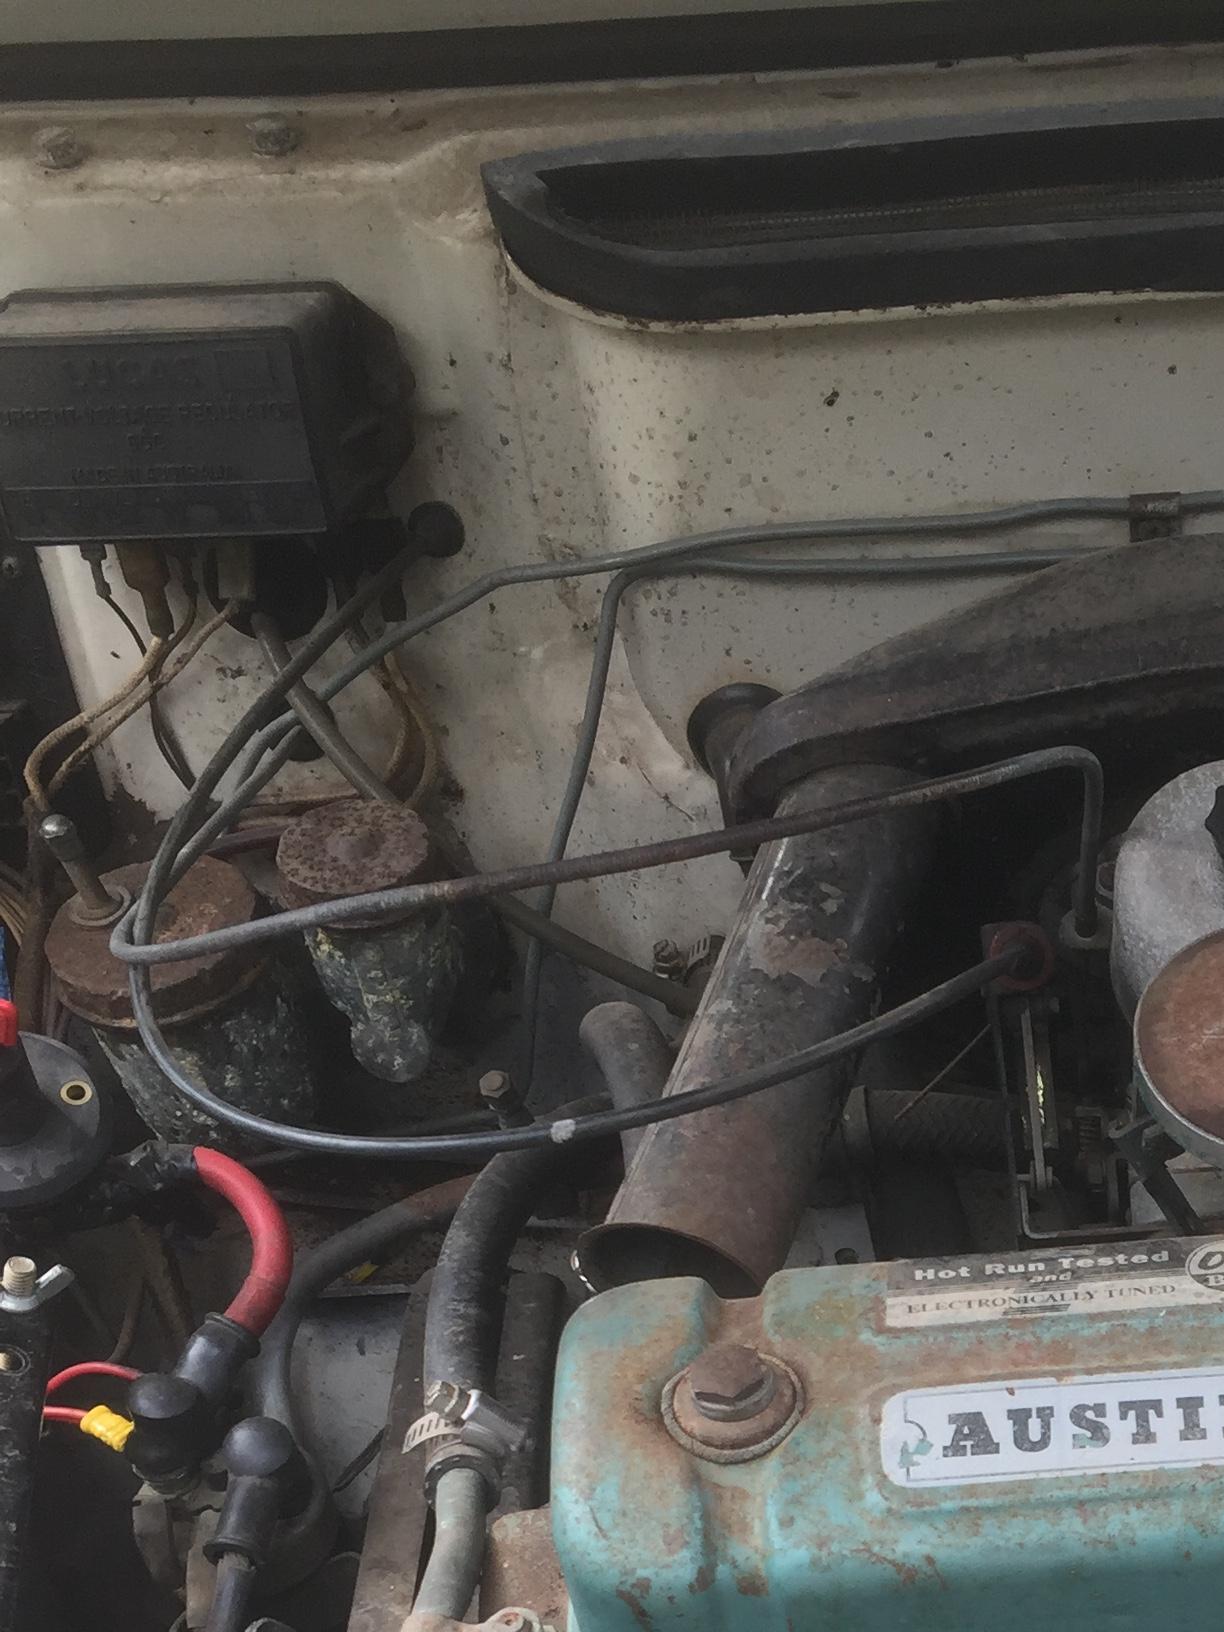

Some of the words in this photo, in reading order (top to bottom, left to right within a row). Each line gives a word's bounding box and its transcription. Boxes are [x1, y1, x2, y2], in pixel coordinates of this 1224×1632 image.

[914, 1265, 971, 1281] Hot
[985, 1261, 1046, 1276] Run
[1058, 1251, 1169, 1269] Tested
[1029, 1271, 1073, 1284] and
[906, 1288, 1098, 1314] ELECTRONICALLY
[1107, 1284, 1176, 1299] TUNED
